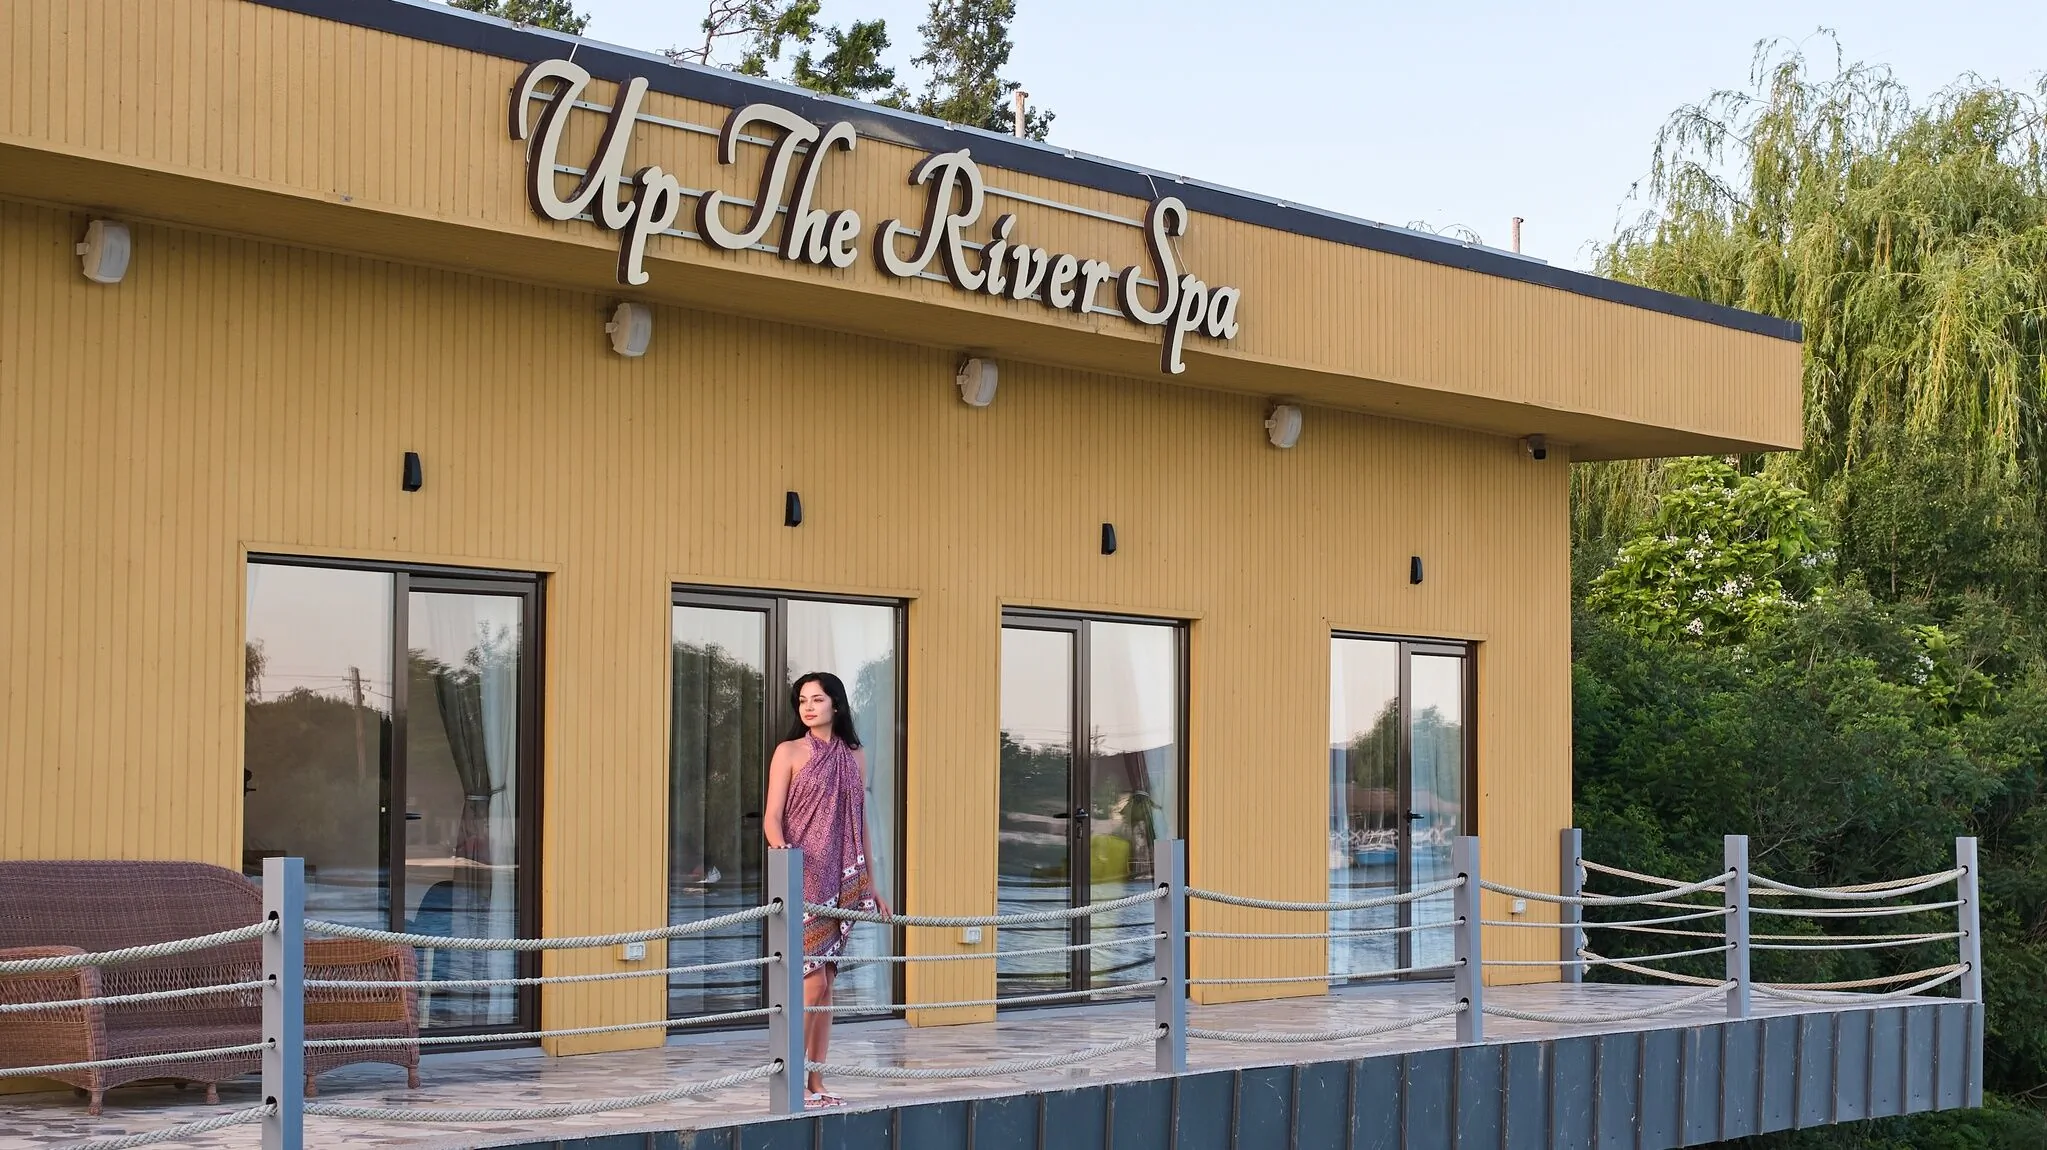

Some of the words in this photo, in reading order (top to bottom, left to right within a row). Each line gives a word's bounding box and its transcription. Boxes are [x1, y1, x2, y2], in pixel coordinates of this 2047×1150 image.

[511, 59, 680, 285] Up
[698, 103, 861, 268] The
[876, 148, 1109, 313] River
[1119, 197, 1240, 374] Spa
